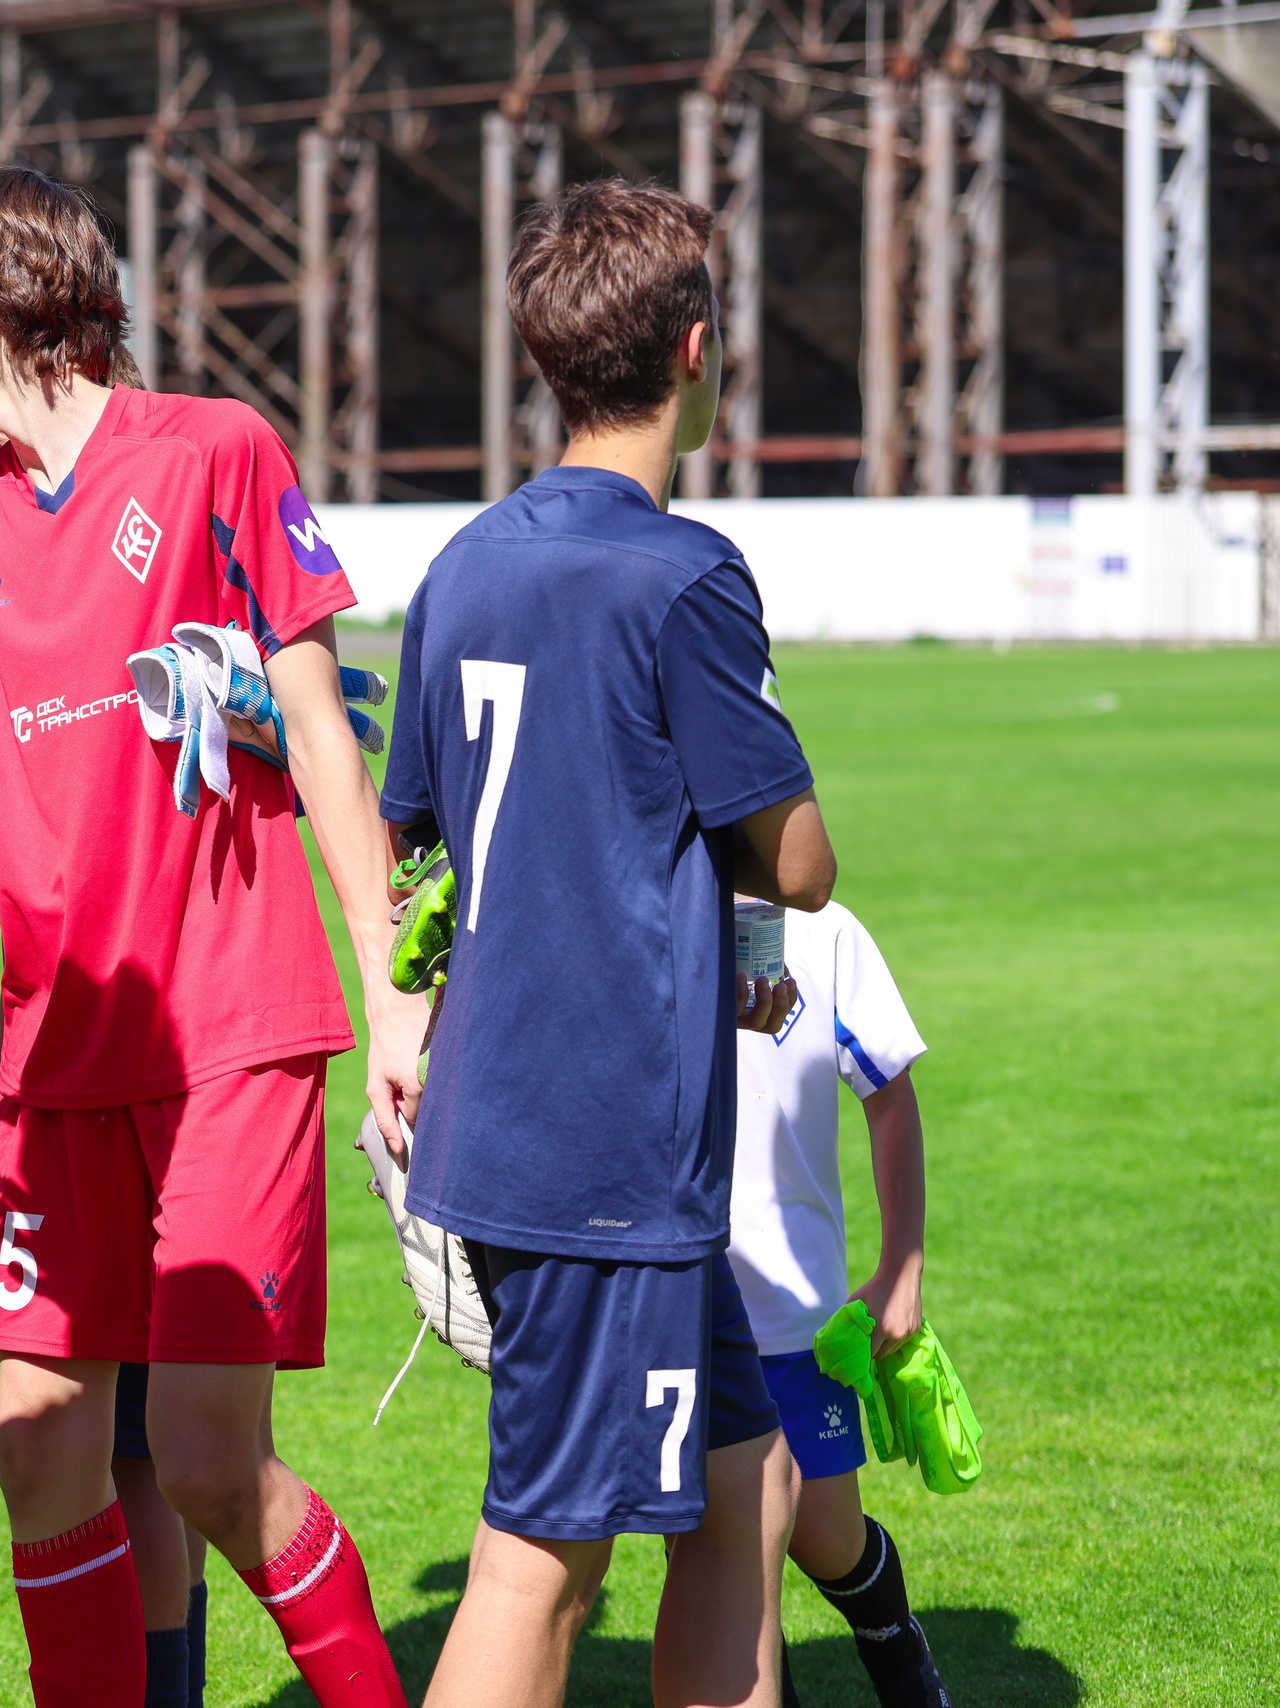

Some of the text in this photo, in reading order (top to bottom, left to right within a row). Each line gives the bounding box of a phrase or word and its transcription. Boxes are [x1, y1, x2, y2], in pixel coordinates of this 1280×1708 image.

[460, 659, 527, 933] 7
[645, 1368, 697, 1493] 7
[818, 1426, 849, 1440] KELME
